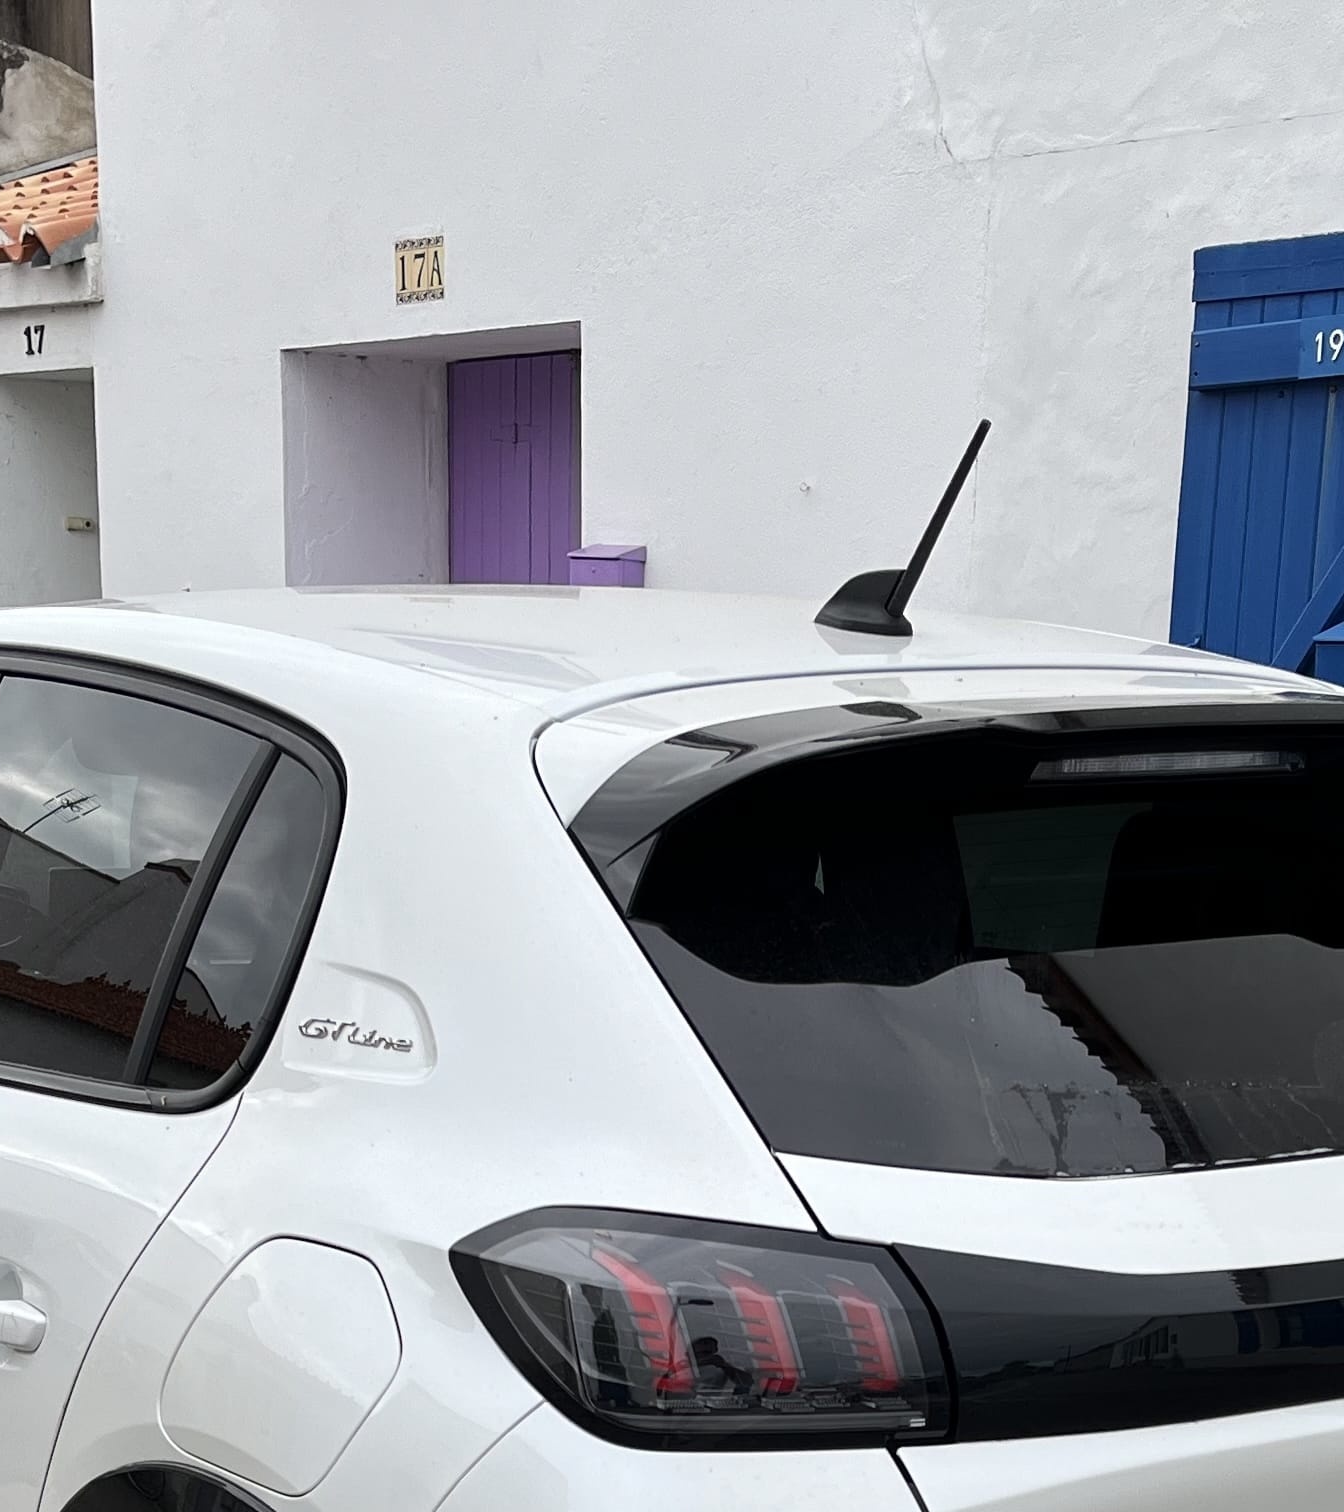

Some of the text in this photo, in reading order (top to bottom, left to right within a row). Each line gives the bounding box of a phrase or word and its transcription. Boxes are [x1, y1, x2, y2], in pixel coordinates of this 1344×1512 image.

[399, 250, 442, 291] 17A
[23, 324, 45, 356] 17
[1315, 328, 1344, 363] 19
